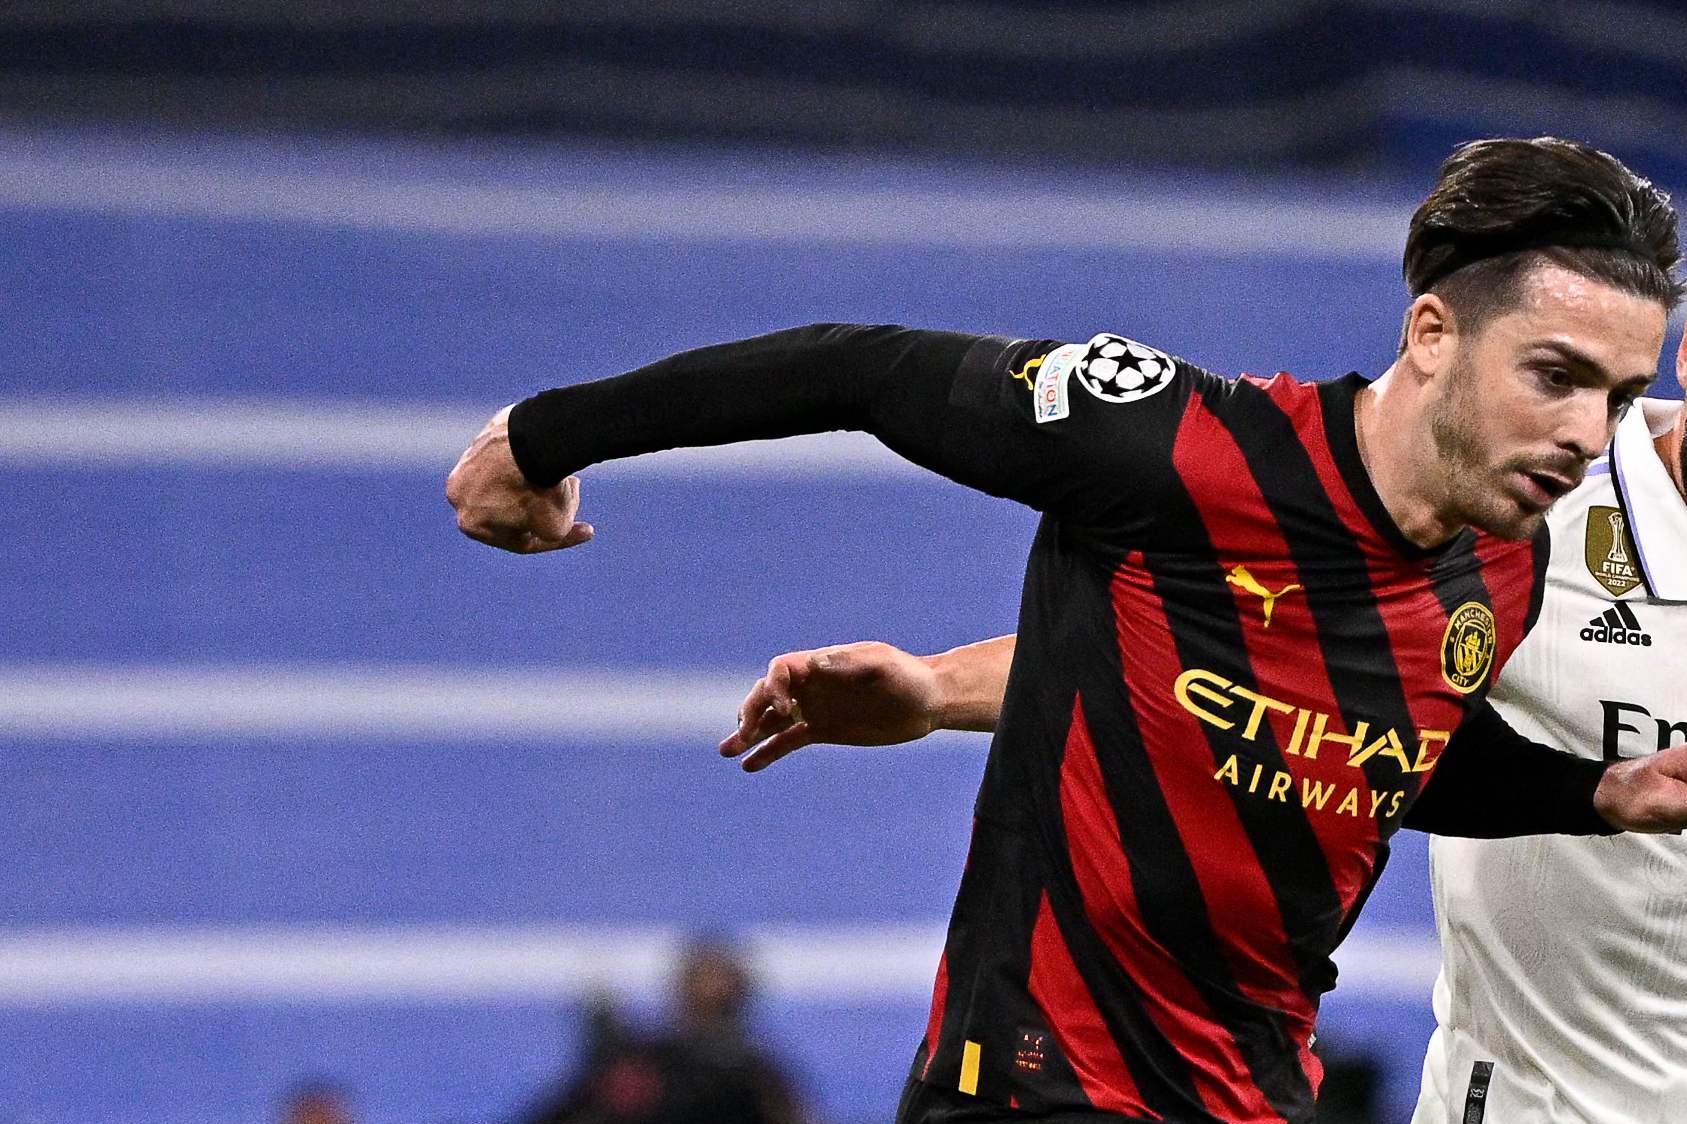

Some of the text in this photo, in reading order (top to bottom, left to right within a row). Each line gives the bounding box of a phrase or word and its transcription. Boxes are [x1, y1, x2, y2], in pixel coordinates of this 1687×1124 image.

[1603, 562, 1633, 576] FIFA
[1608, 579, 1626, 587] 2022
[1580, 626, 1652, 647] adidas
[1452, 673, 1468, 686] CITY
[1174, 668, 1450, 773] ETIHAD
[1214, 754, 1404, 818] AIRWAYS
